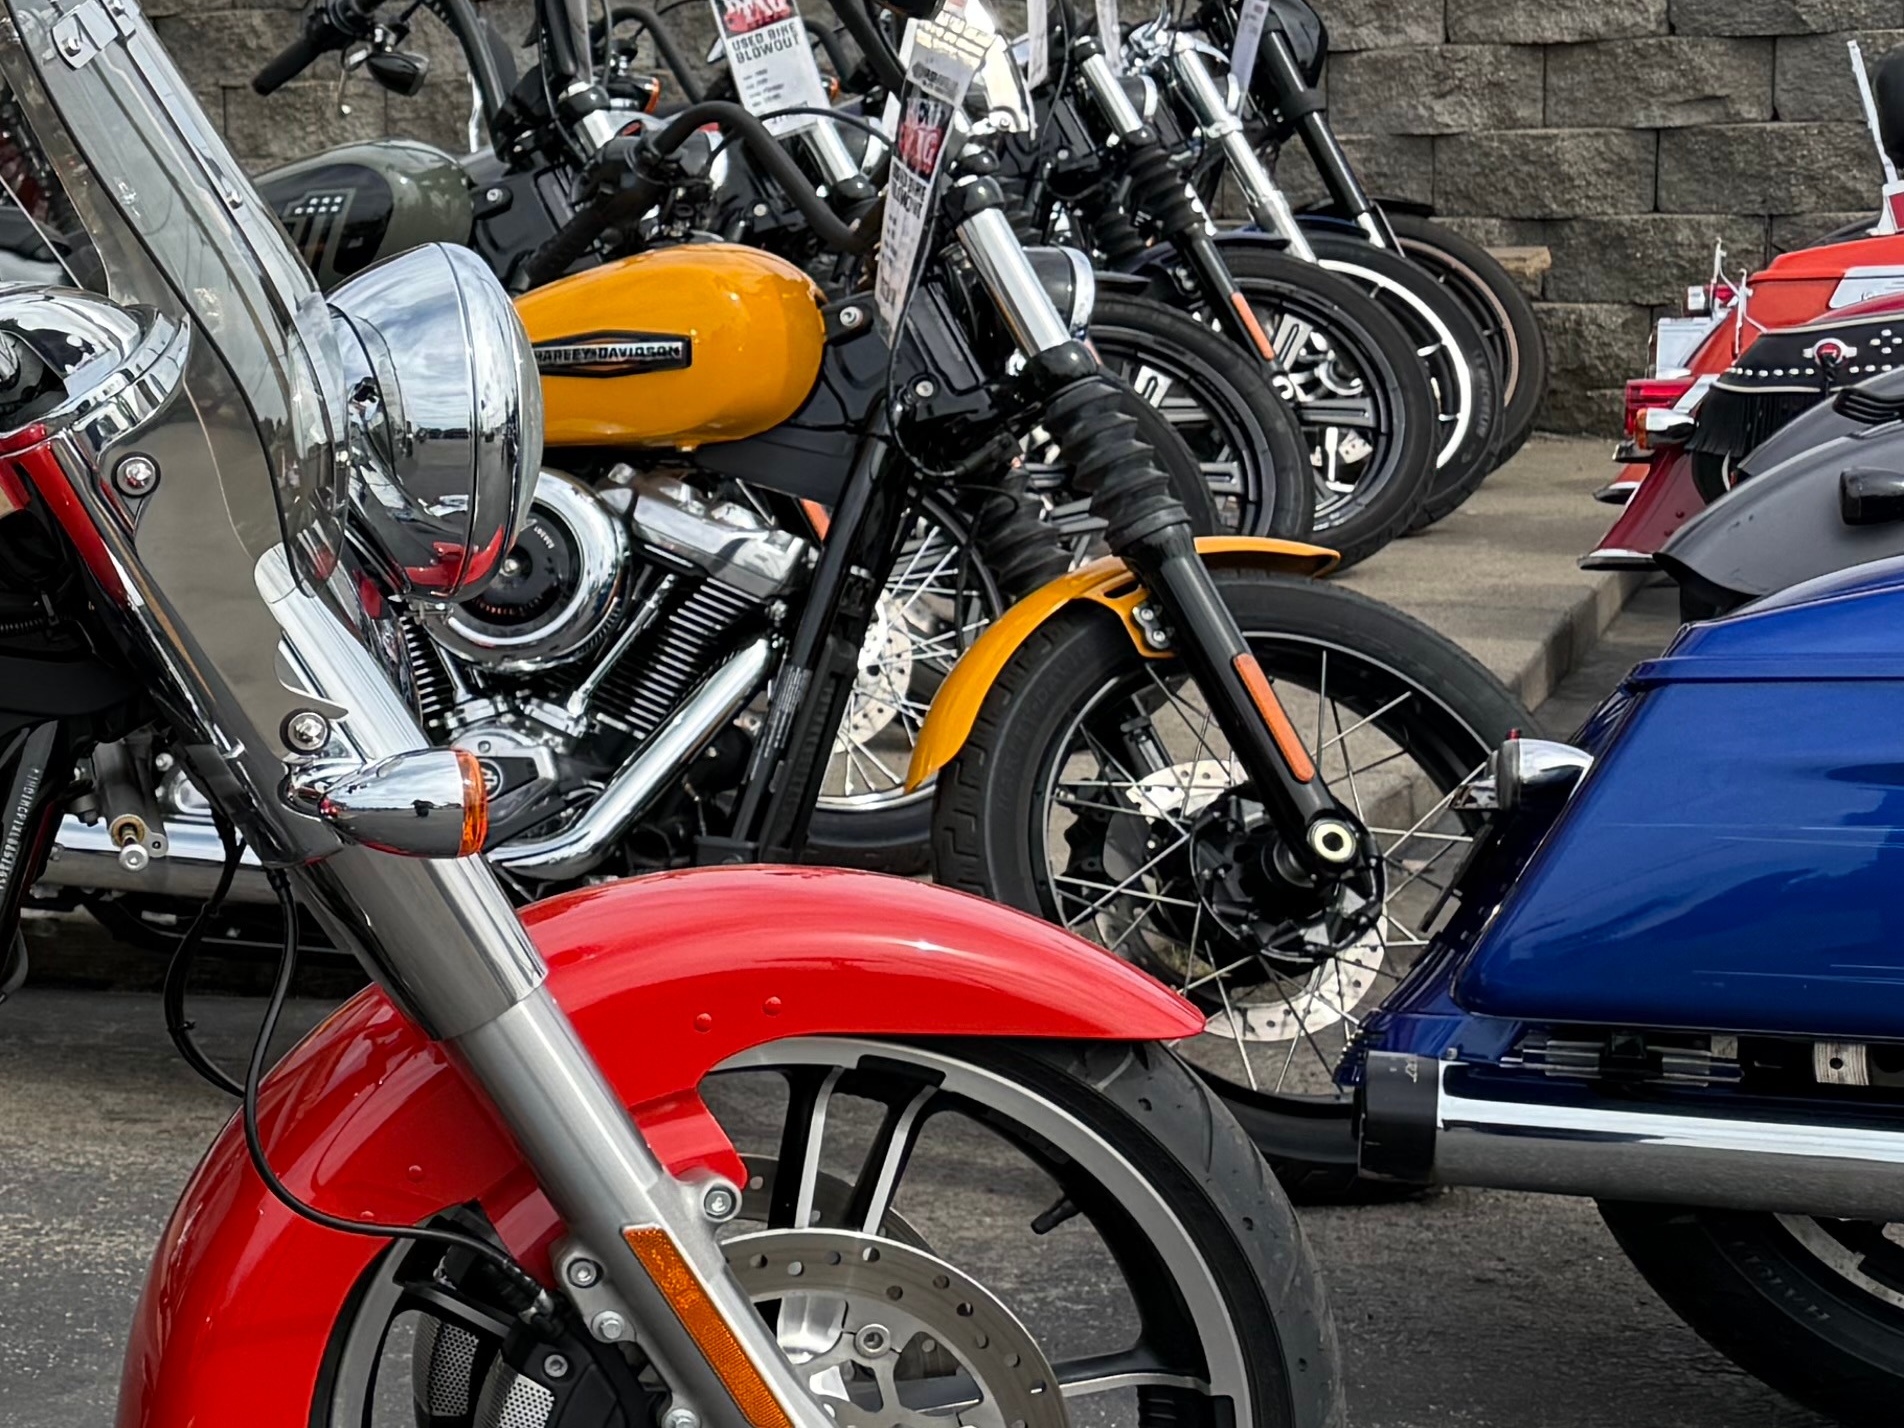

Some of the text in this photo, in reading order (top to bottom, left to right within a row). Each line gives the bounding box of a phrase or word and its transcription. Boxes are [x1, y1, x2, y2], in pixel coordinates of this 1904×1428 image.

[732, 21, 797, 52] USED BIKE
[735, 33, 801, 65] BLOWOUT
